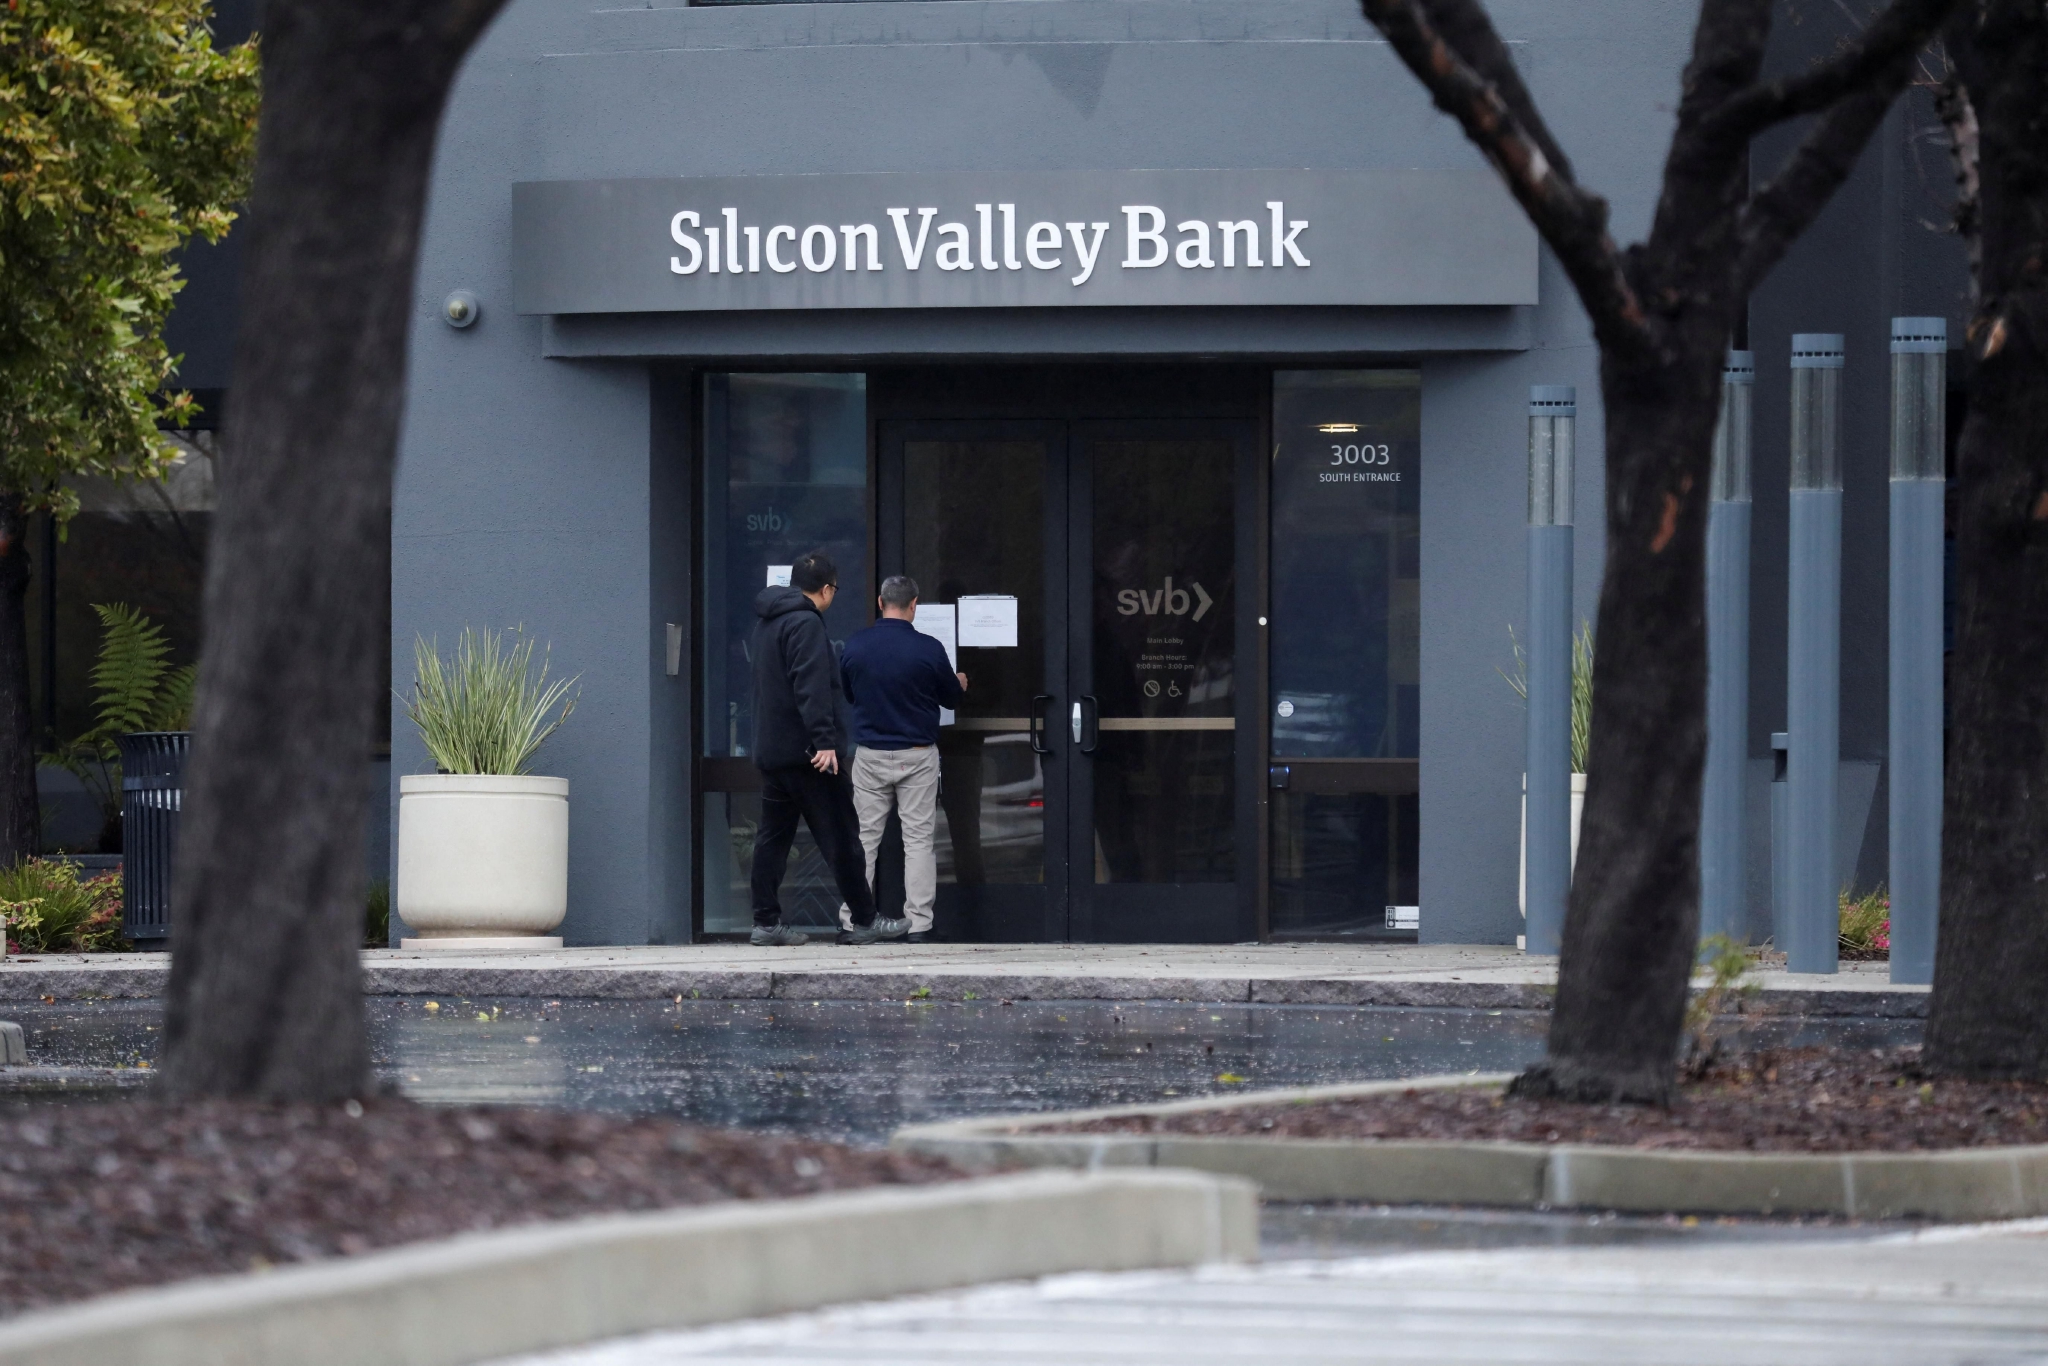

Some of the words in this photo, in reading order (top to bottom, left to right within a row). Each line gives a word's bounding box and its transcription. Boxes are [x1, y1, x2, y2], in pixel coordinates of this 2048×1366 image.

[670, 206, 883, 275] Silicon
[887, 203, 1110, 287] Valley
[1120, 201, 1311, 270] Bank
[1330, 444, 1390, 466] 3003
[1319, 473, 1351, 482] SOUTH
[1353, 472, 1402, 482] ENTRANCE
[746, 506, 782, 532] svb
[1116, 576, 1191, 616] svb
[1164, 637, 1184, 646] Lobby
